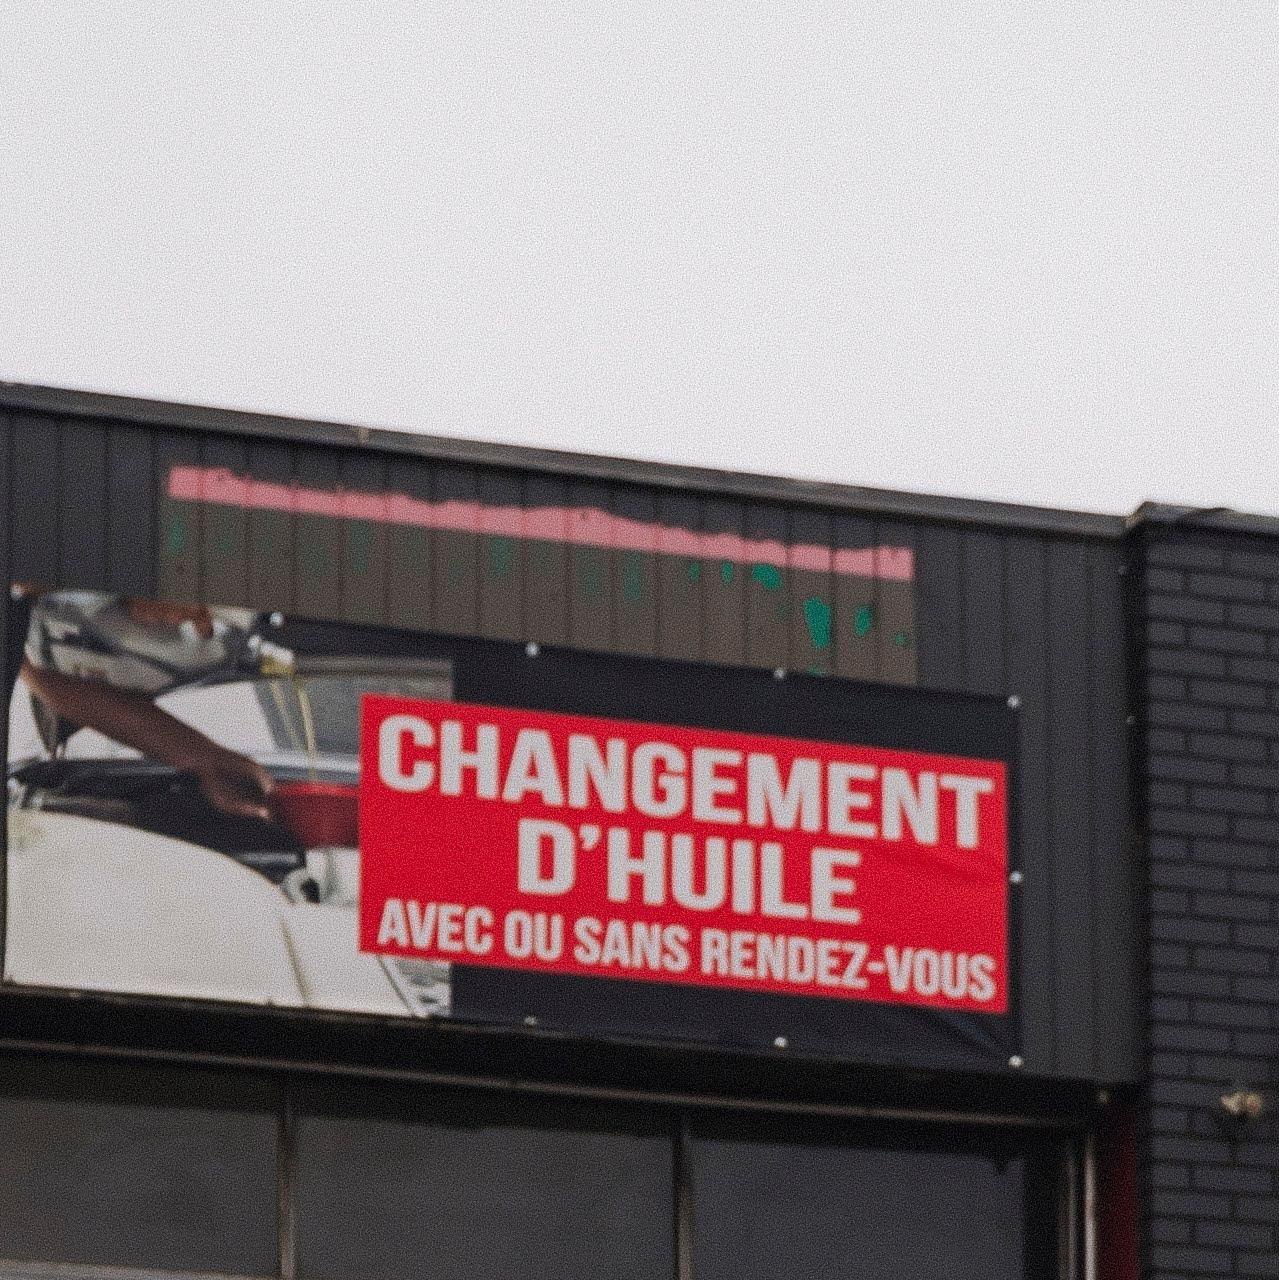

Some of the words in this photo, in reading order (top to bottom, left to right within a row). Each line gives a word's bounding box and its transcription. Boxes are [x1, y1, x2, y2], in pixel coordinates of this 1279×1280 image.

[378, 714, 995, 848] CHANGEMENT
[377, 899, 494, 955] AVEC
[504, 910, 564, 961] OU
[574, 915, 691, 973] SANS
[701, 928, 996, 1002] RENDEZ-VOUS
